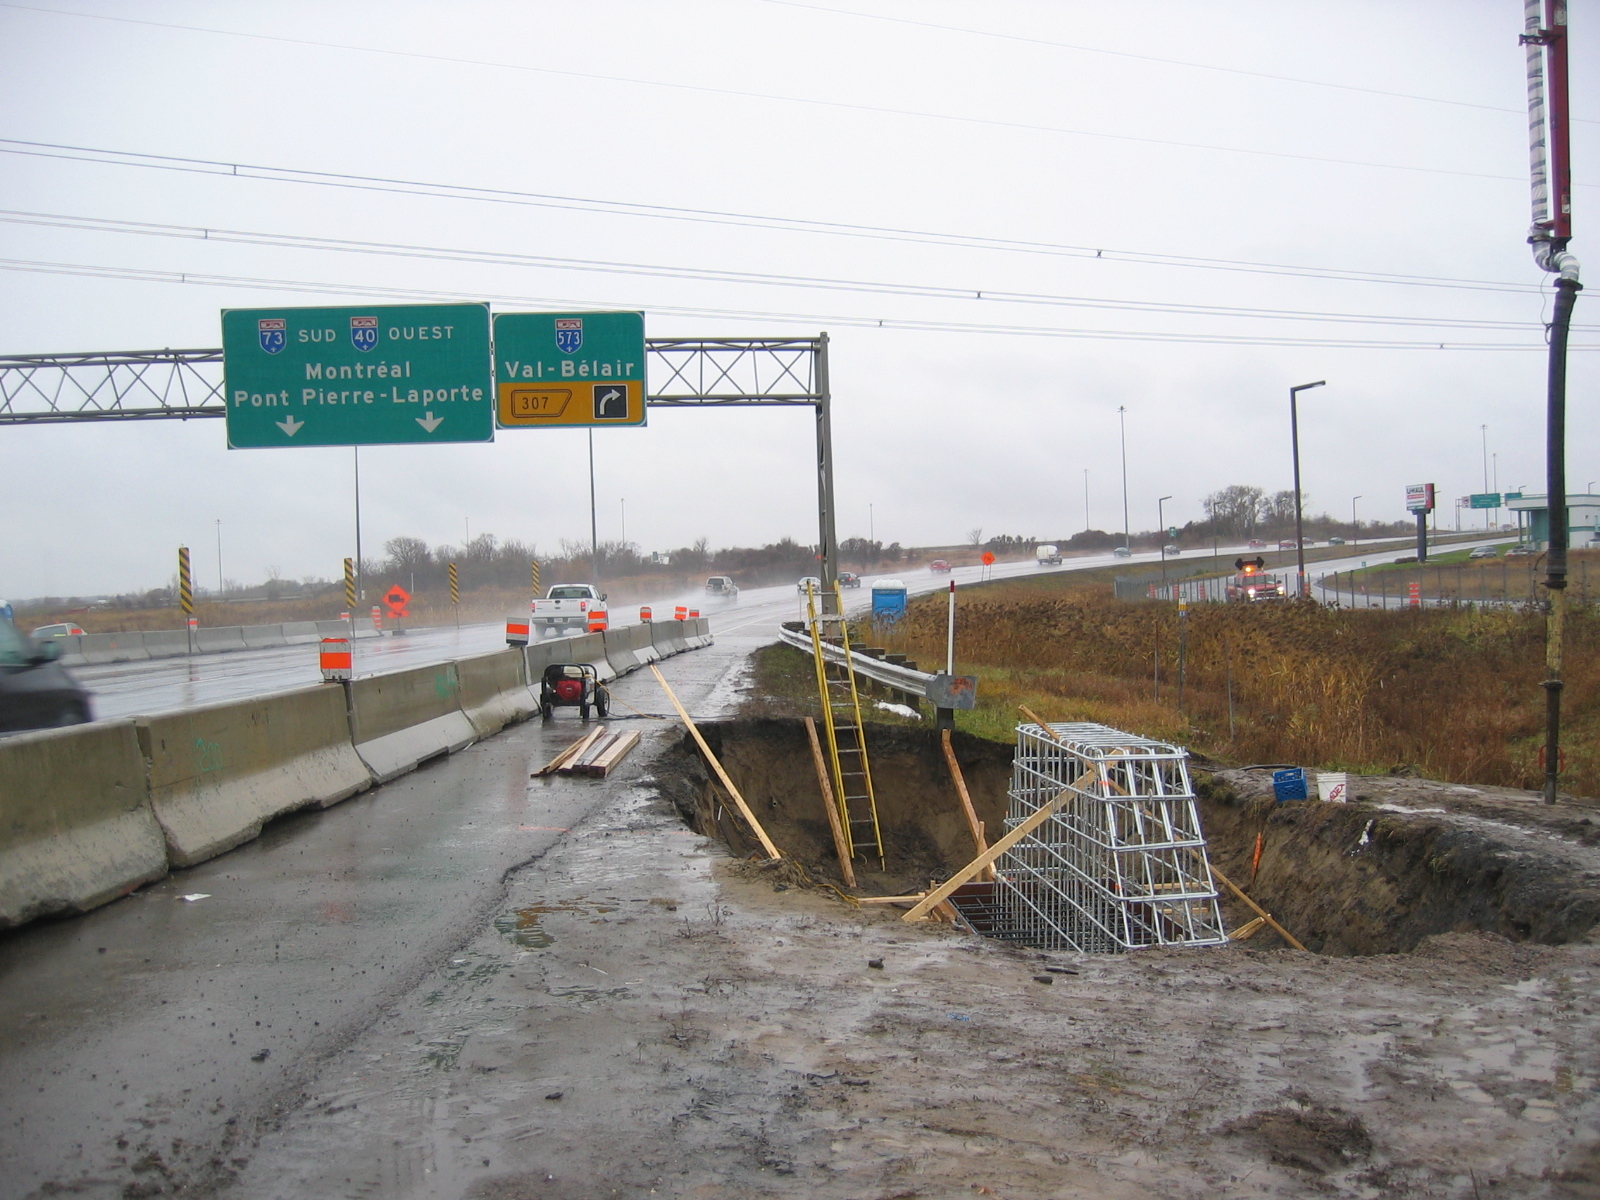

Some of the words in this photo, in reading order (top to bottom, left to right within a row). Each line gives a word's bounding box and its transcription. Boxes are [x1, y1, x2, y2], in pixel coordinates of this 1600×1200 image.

[262, 331, 284, 345] 73
[298, 329, 337, 343] SUD
[354, 329, 376, 343] 40
[388, 326, 455, 340] OUEST
[558, 331, 580, 345] 573
[306, 361, 411, 380] Montréal
[505, 360, 635, 378] Val-Bélair
[234, 390, 290, 407] Pont
[302, 385, 483, 406] Pierre-Laporte
[522, 396, 549, 410] 307
